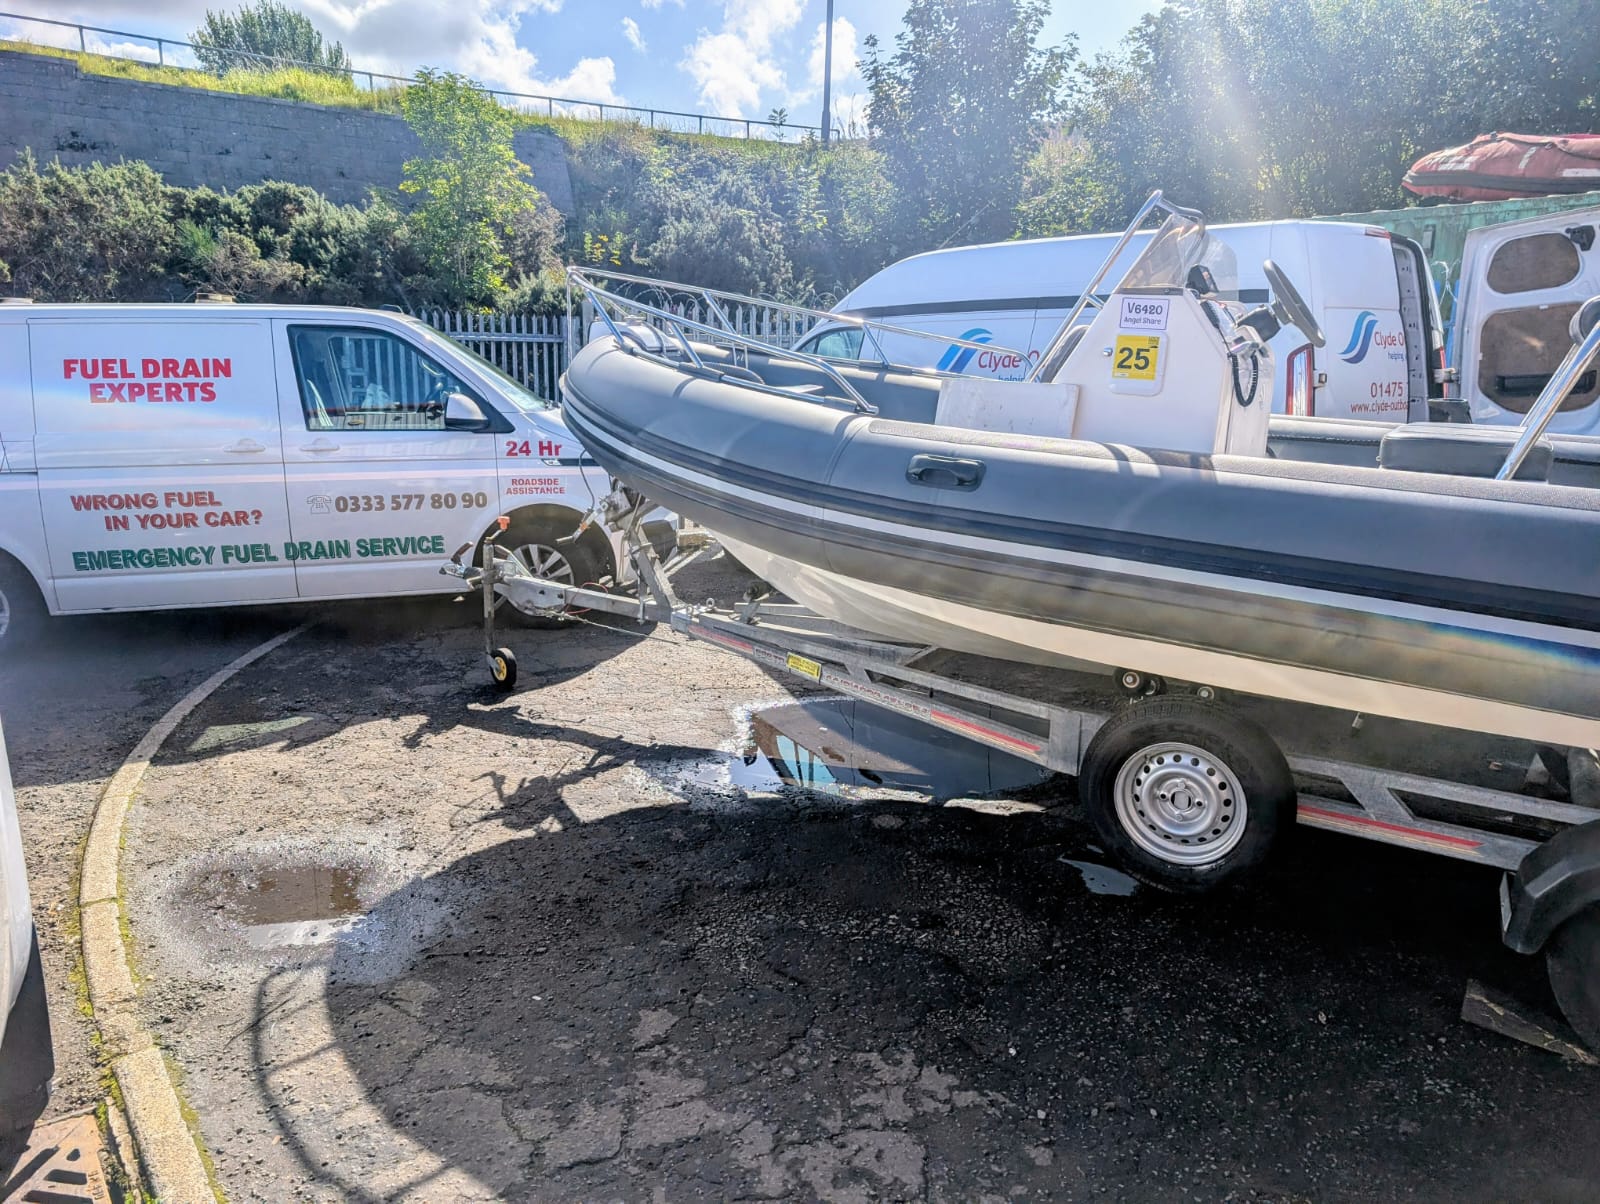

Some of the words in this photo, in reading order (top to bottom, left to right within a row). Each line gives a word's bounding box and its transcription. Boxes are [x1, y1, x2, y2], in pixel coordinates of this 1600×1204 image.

[1127, 302, 1163, 315] V6420
[1124, 316, 1141, 325] Angel
[1143, 317, 1161, 325] Share
[1374, 331, 1397, 349] Clyde
[1117, 346, 1150, 371] 25
[63, 359, 135, 379] FUEL
[142, 358, 232, 378] DRAIN
[89, 382, 217, 403] EXPERTS
[1370, 381, 1403, 398] 01475
[505, 440, 531, 457] 24
[538, 441, 562, 456] Hr
[506, 486, 565, 495] ASSISTANCE
[511, 478, 559, 486] ROADSIDE
[70, 493, 158, 511] WRONG
[164, 491, 222, 508] FUEL
[335, 495, 385, 512] 0333
[390, 494, 425, 511] 577
[430, 492, 457, 509] 80
[462, 491, 488, 509] 90
[105, 515, 130, 531] IN
[135, 513, 200, 530] YOUR
[204, 510, 263, 527] CAR?
[72, 545, 216, 571] EMERGENCY
[221, 543, 278, 564] FUEL
[284, 540, 351, 561] DRAIN
[356, 535, 445, 557] SERVICE
